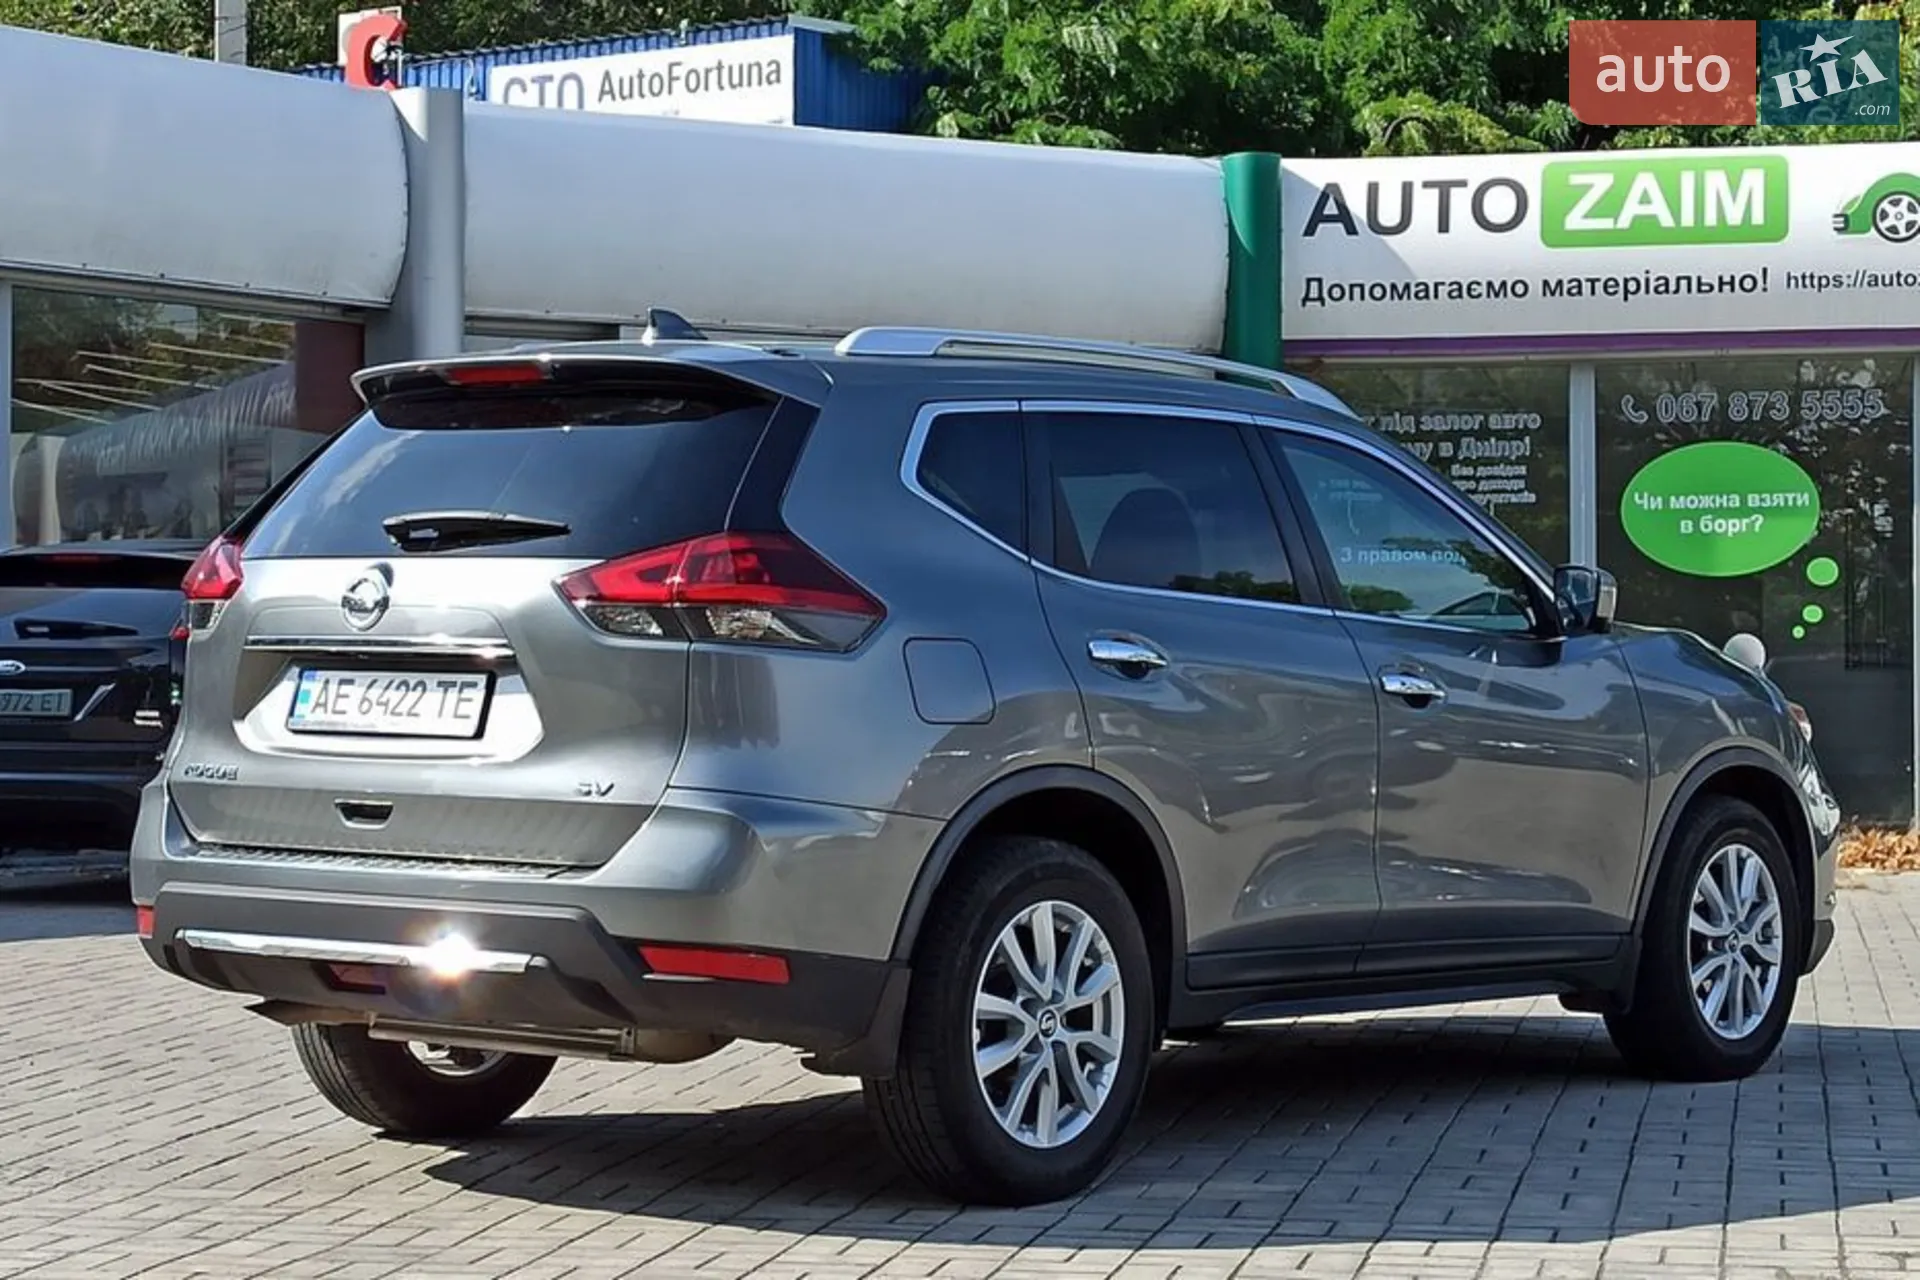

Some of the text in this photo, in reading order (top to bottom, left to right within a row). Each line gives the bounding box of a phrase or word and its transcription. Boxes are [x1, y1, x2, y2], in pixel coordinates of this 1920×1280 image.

[598, 59, 782, 103] AutoFortuna
[1302, 168, 1765, 237] AUTO ZAIM
[1301, 267, 1769, 308] Допомагаємо матеріально!
[1785, 269, 1920, 291] https://auto
[1420, 413, 1484, 432] залог
[1488, 412, 1542, 431] авто
[1656, 388, 1884, 423] 067 873 5555
[1634, 490, 1810, 511] Чи можна взяти
[1680, 514, 1764, 536] в борг?
[311, 678, 478, 719] AE 6422 TE
